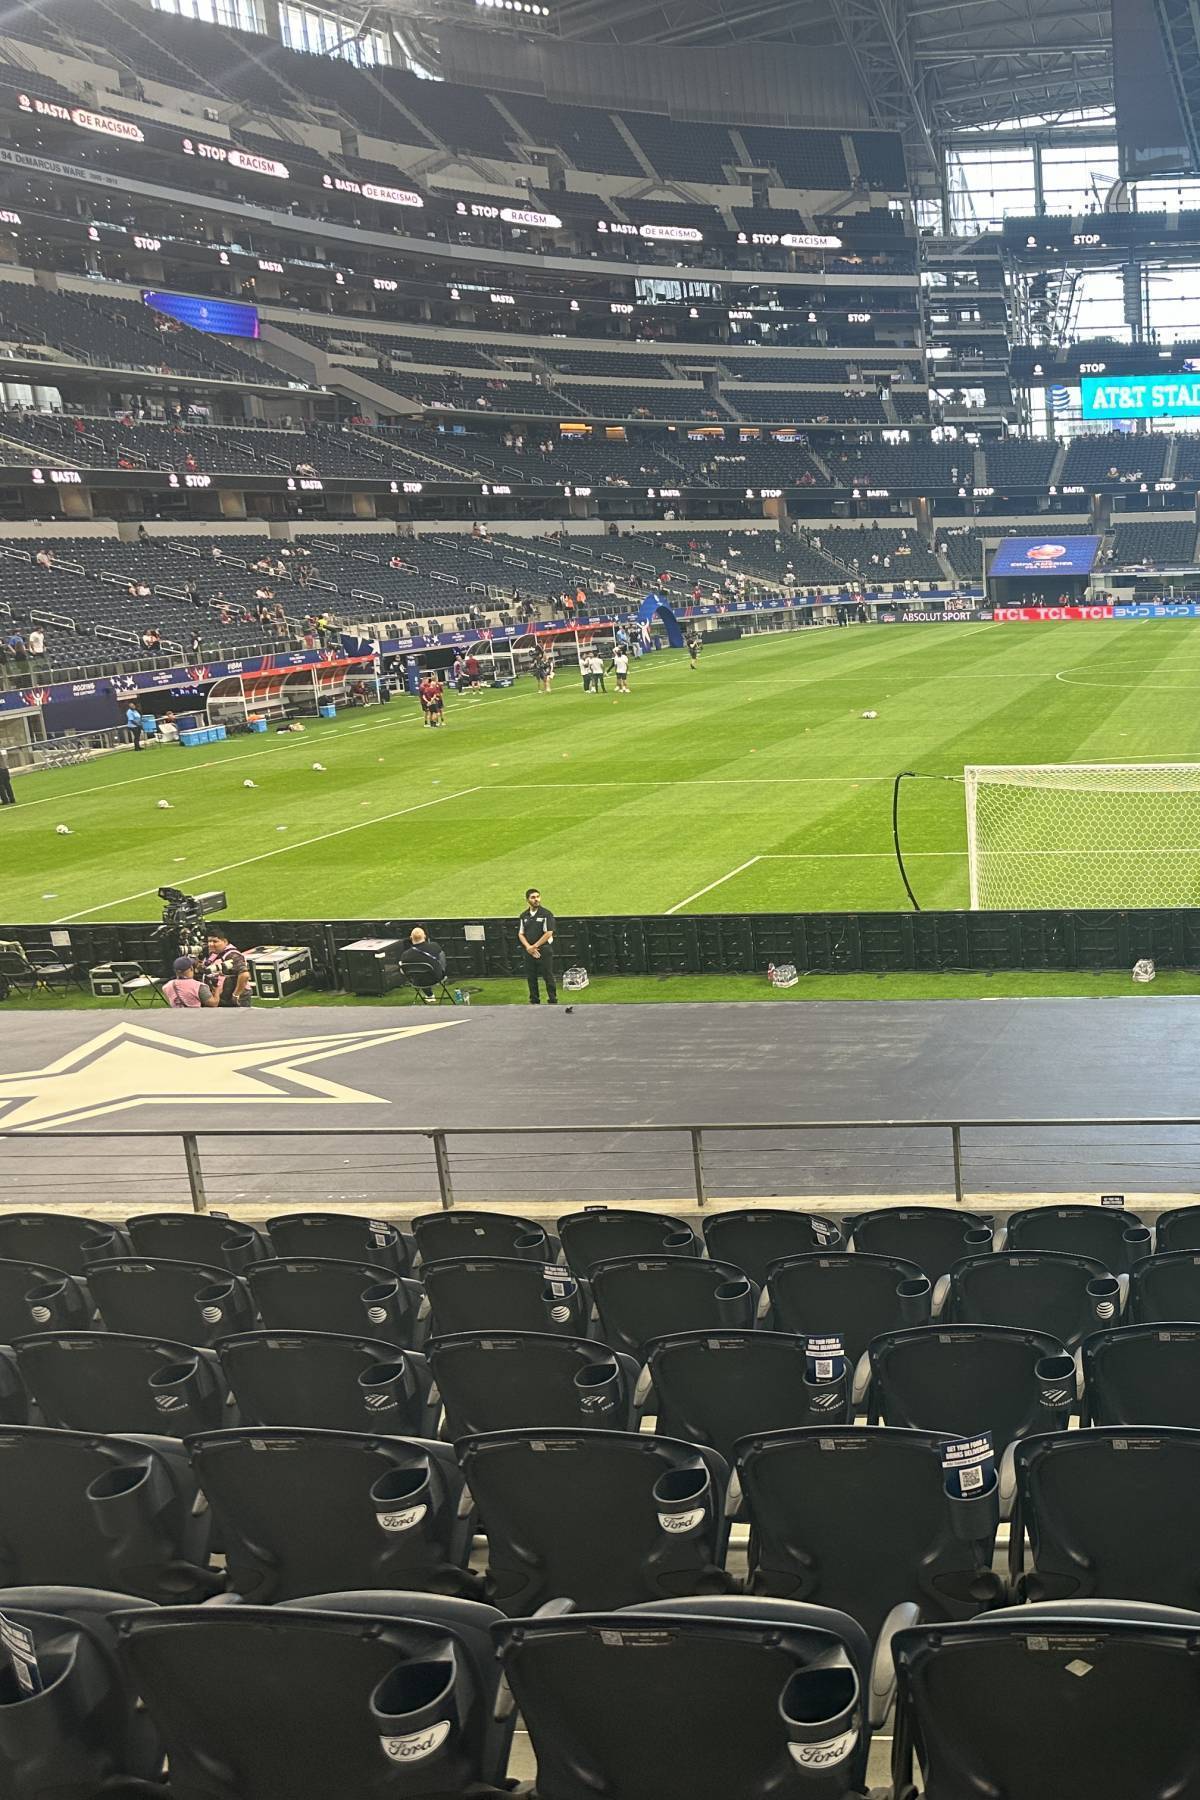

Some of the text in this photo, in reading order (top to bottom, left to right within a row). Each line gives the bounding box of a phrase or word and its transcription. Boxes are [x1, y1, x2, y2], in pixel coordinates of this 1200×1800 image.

[35, 101, 138, 137] BASTA DE RACISMO
[198, 144, 275, 173] STOP RACISM
[1, 151, 12, 162] 94
[15, 154, 61, 174] DeMARCUS
[62, 165, 86, 179] WARE
[335, 179, 418, 203] BASTA DE RACISMO
[472, 205, 546, 225] STOP RACISM
[611, 224, 697, 239] BASTA DE RACISMO
[134, 236, 160, 251] STOP
[752, 234, 827, 246] STOP RACISM
[1074, 235, 1100, 244] STOP
[259, 260, 283, 272] BASTA
[374, 279, 397, 290] STOP
[491, 294, 515, 304] BASTA
[611, 304, 633, 313] STOP
[729, 311, 752, 319] BASTA
[848, 314, 870, 322] STOP
[1080, 364, 1105, 372] STOP
[1092, 385, 1147, 410] AT&T
[51, 471, 81, 482] BASTA
[186, 475, 210, 487] STOP
[301, 480, 323, 489] BASTA
[403, 483, 422, 492] STOP
[1155, 483, 1176, 491] STOP
[575, 488, 591, 496] STOP
[998, 610, 1029, 620] TCL
[1037, 609, 1070, 619] TCL
[1080, 608, 1112, 618] TCL
[1114, 608, 1149, 617] BYD
[1155, 605, 1189, 615] BYD
[902, 612, 941, 621] ABSOLUT
[942, 611, 971, 620] SPORT
[382, 1510, 416, 1529] Ford
[662, 1513, 695, 1531] Ford
[388, 1730, 437, 1757] Ford
[799, 1740, 847, 1766] Ford
